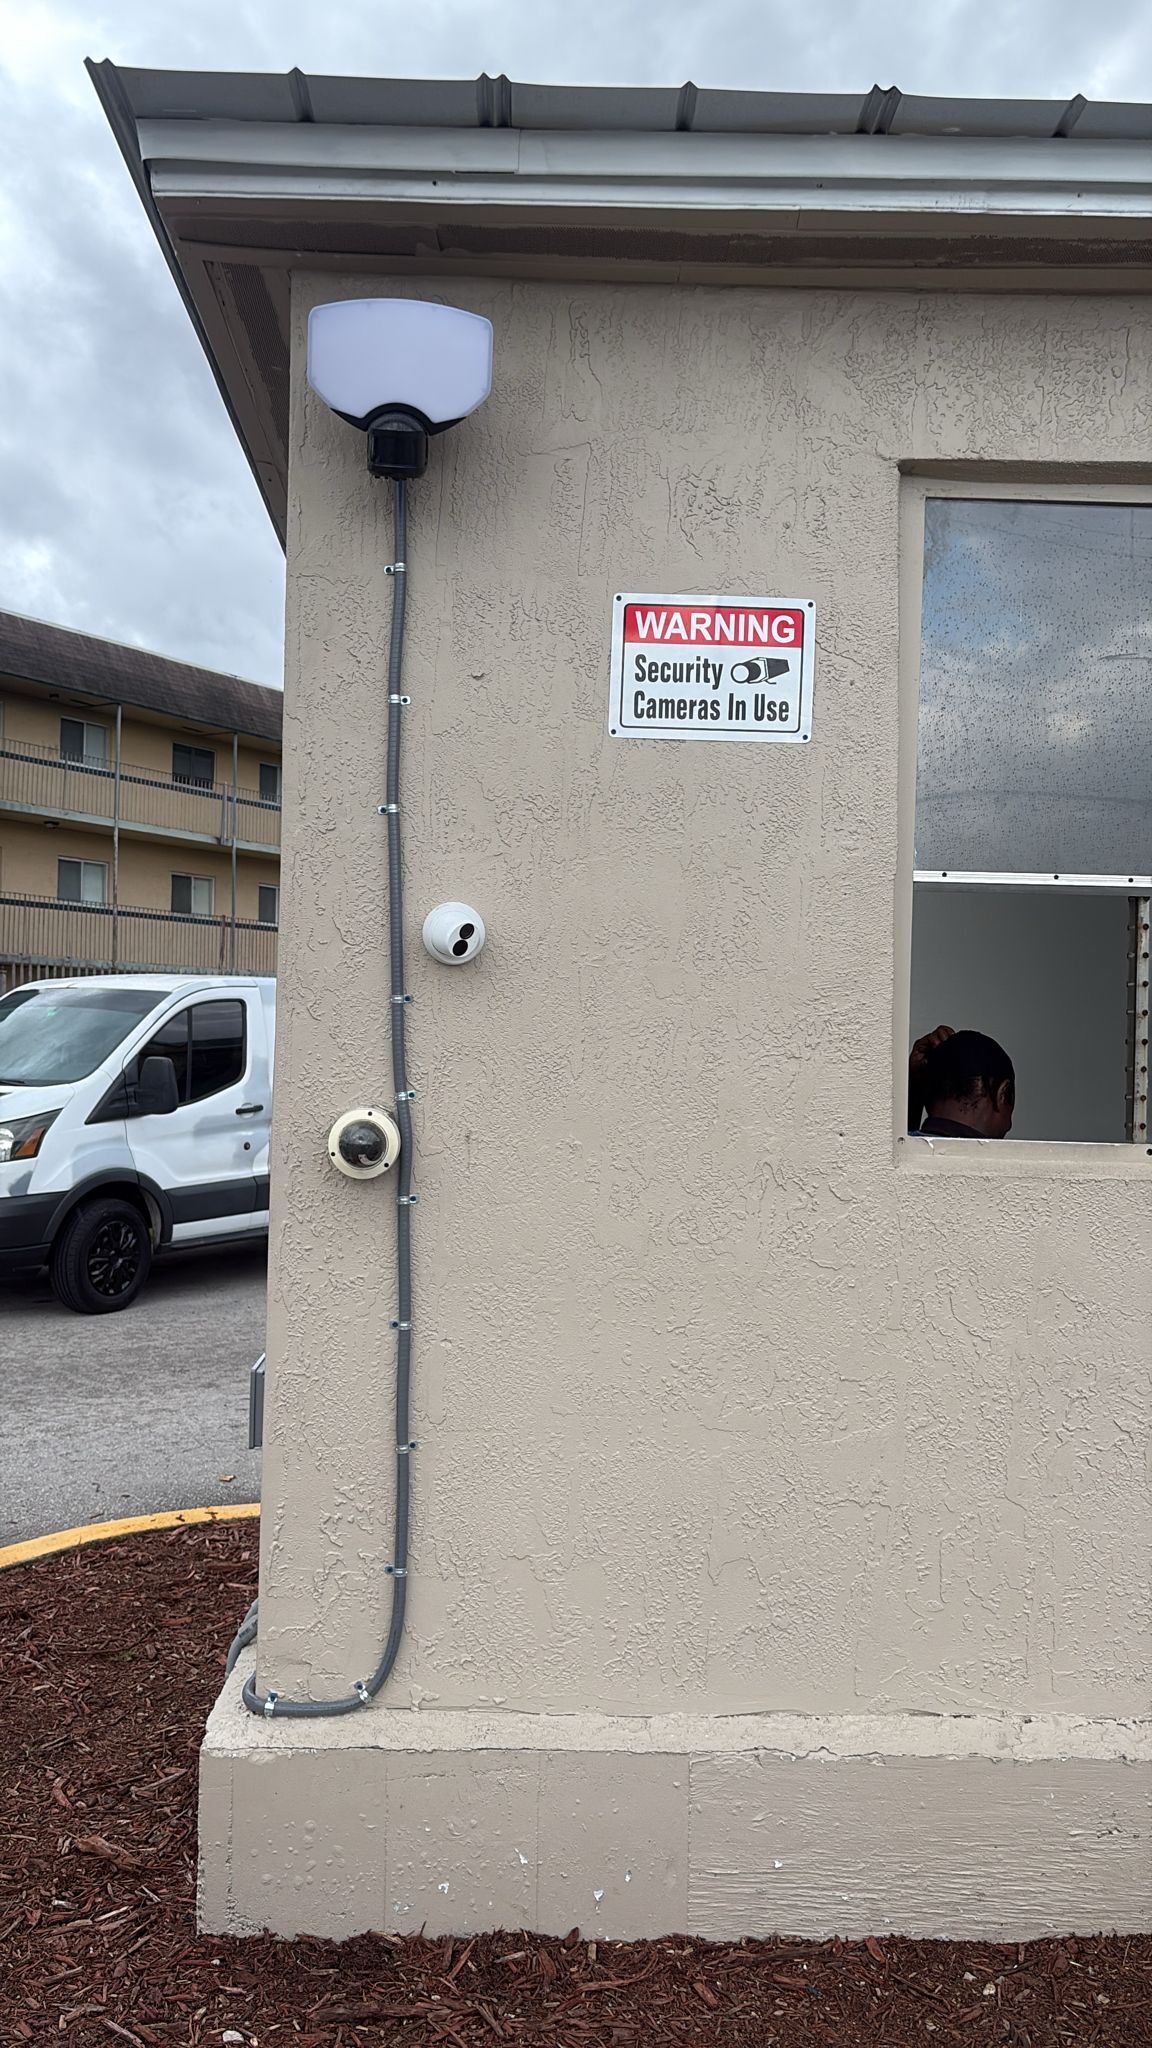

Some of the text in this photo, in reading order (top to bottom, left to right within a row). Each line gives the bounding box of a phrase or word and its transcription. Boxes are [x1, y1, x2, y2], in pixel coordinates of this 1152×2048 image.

[635, 611, 796, 643] WARNING
[634, 654, 723, 690] Security
[633, 690, 789, 722] Cameras In Use
